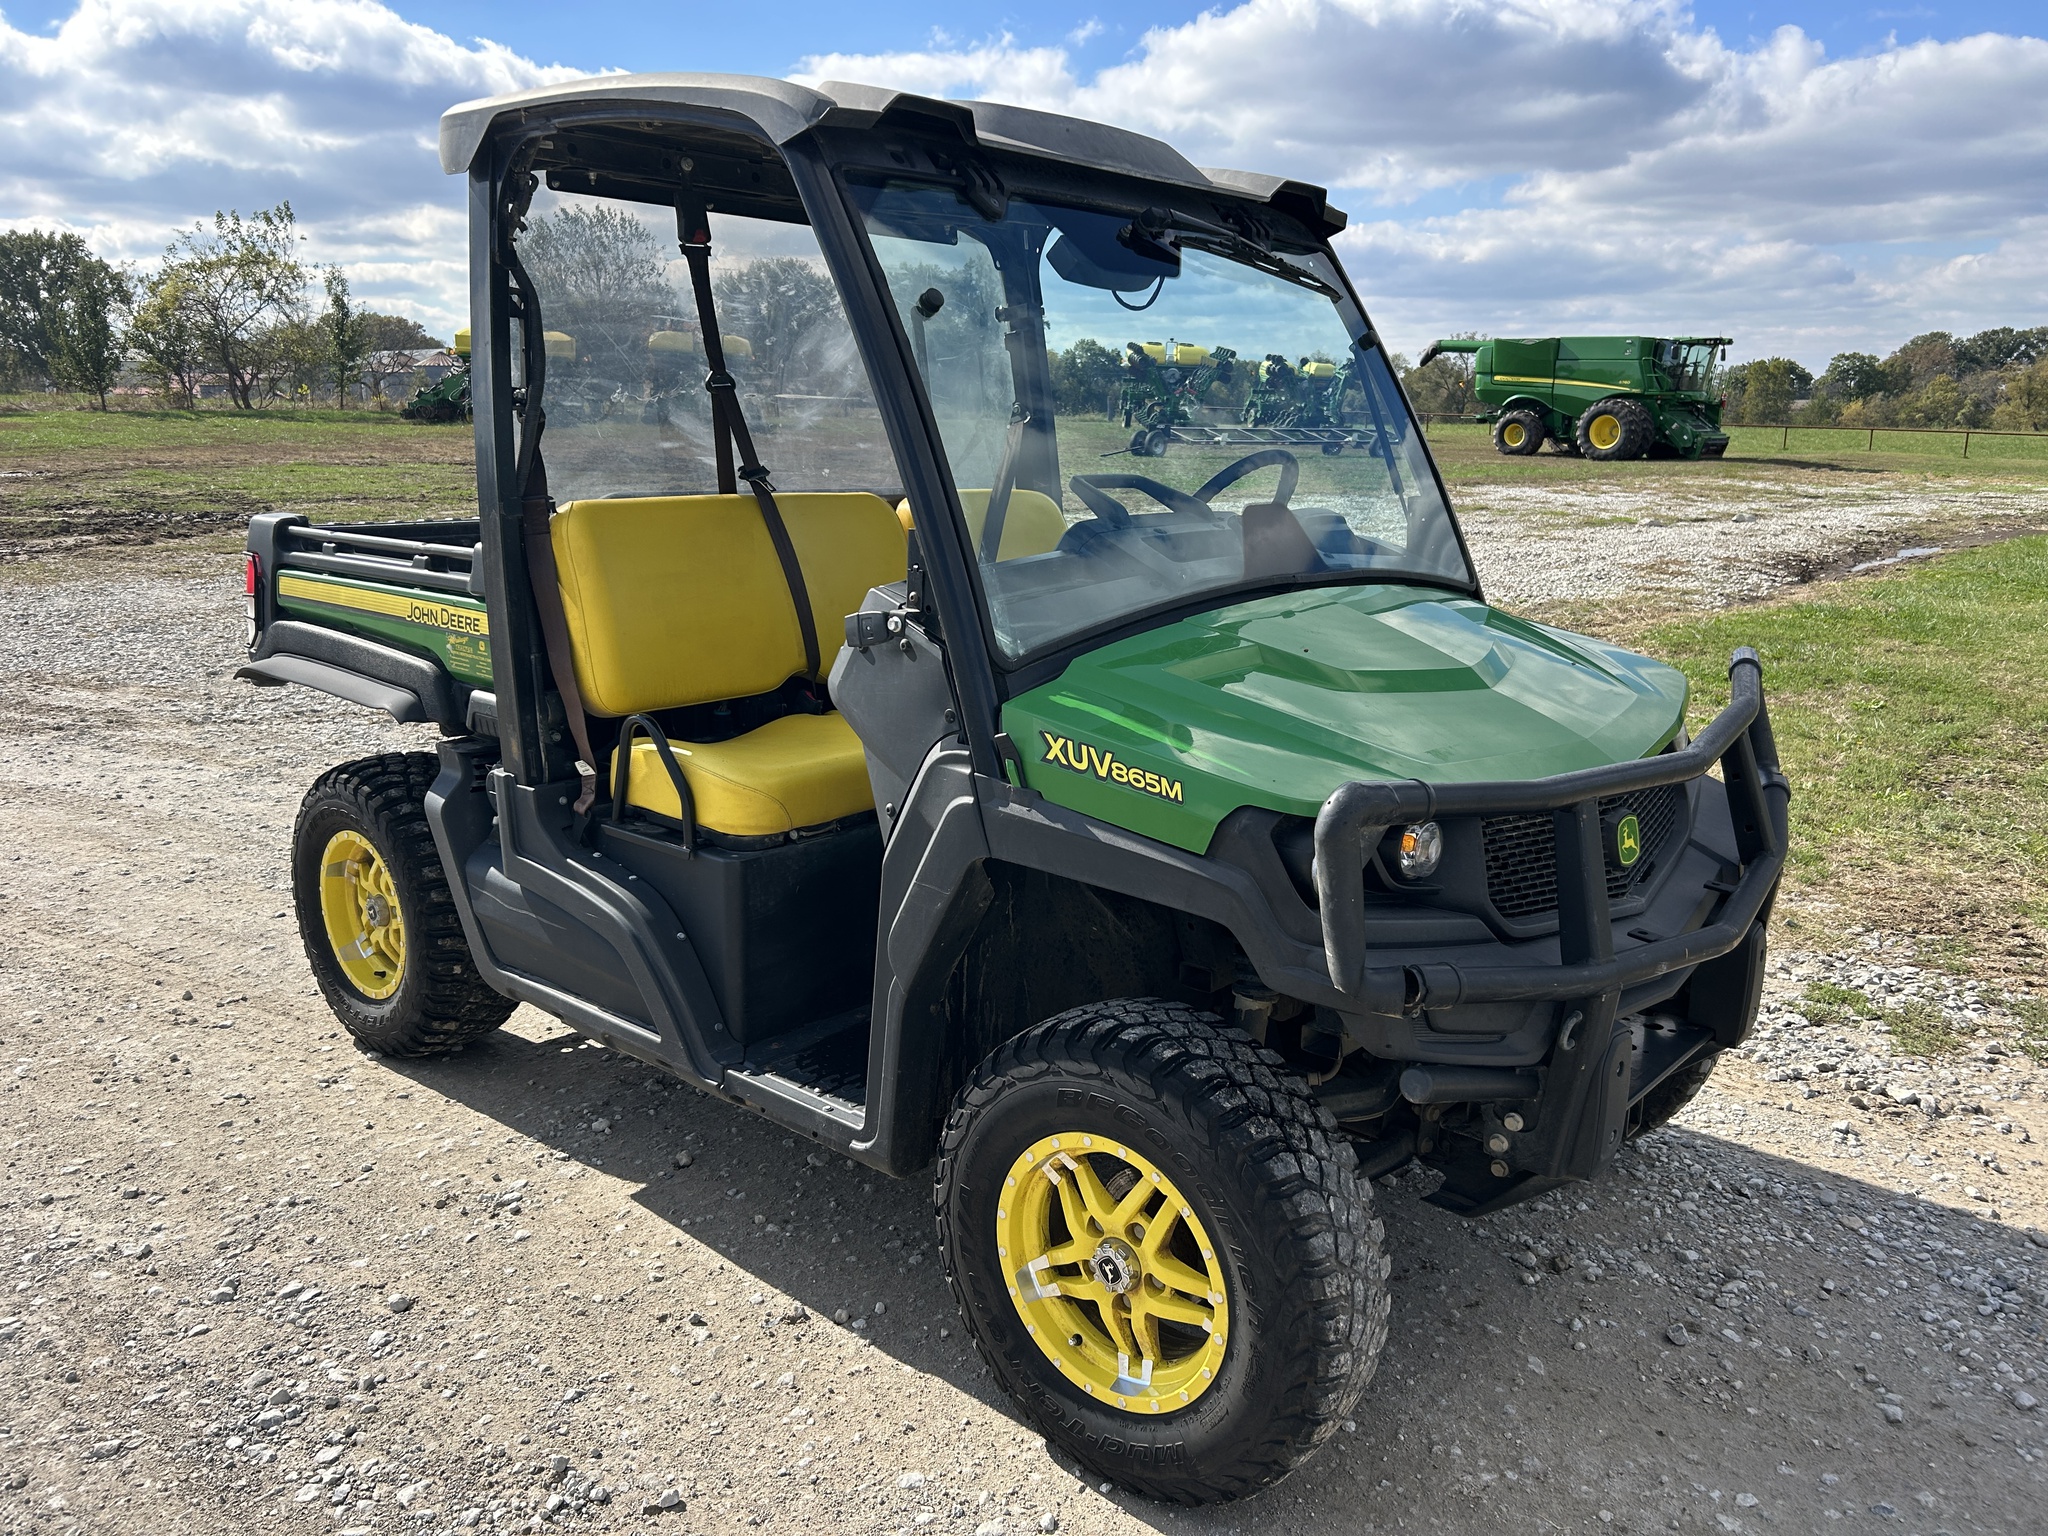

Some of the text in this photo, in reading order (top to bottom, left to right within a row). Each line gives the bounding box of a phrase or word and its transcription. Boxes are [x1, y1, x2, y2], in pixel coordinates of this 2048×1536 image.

[407, 602, 481, 633] JOHN DEERE
[1041, 730, 1184, 804] XUV865M
[1057, 1087, 1265, 1335] BFGoodrich
